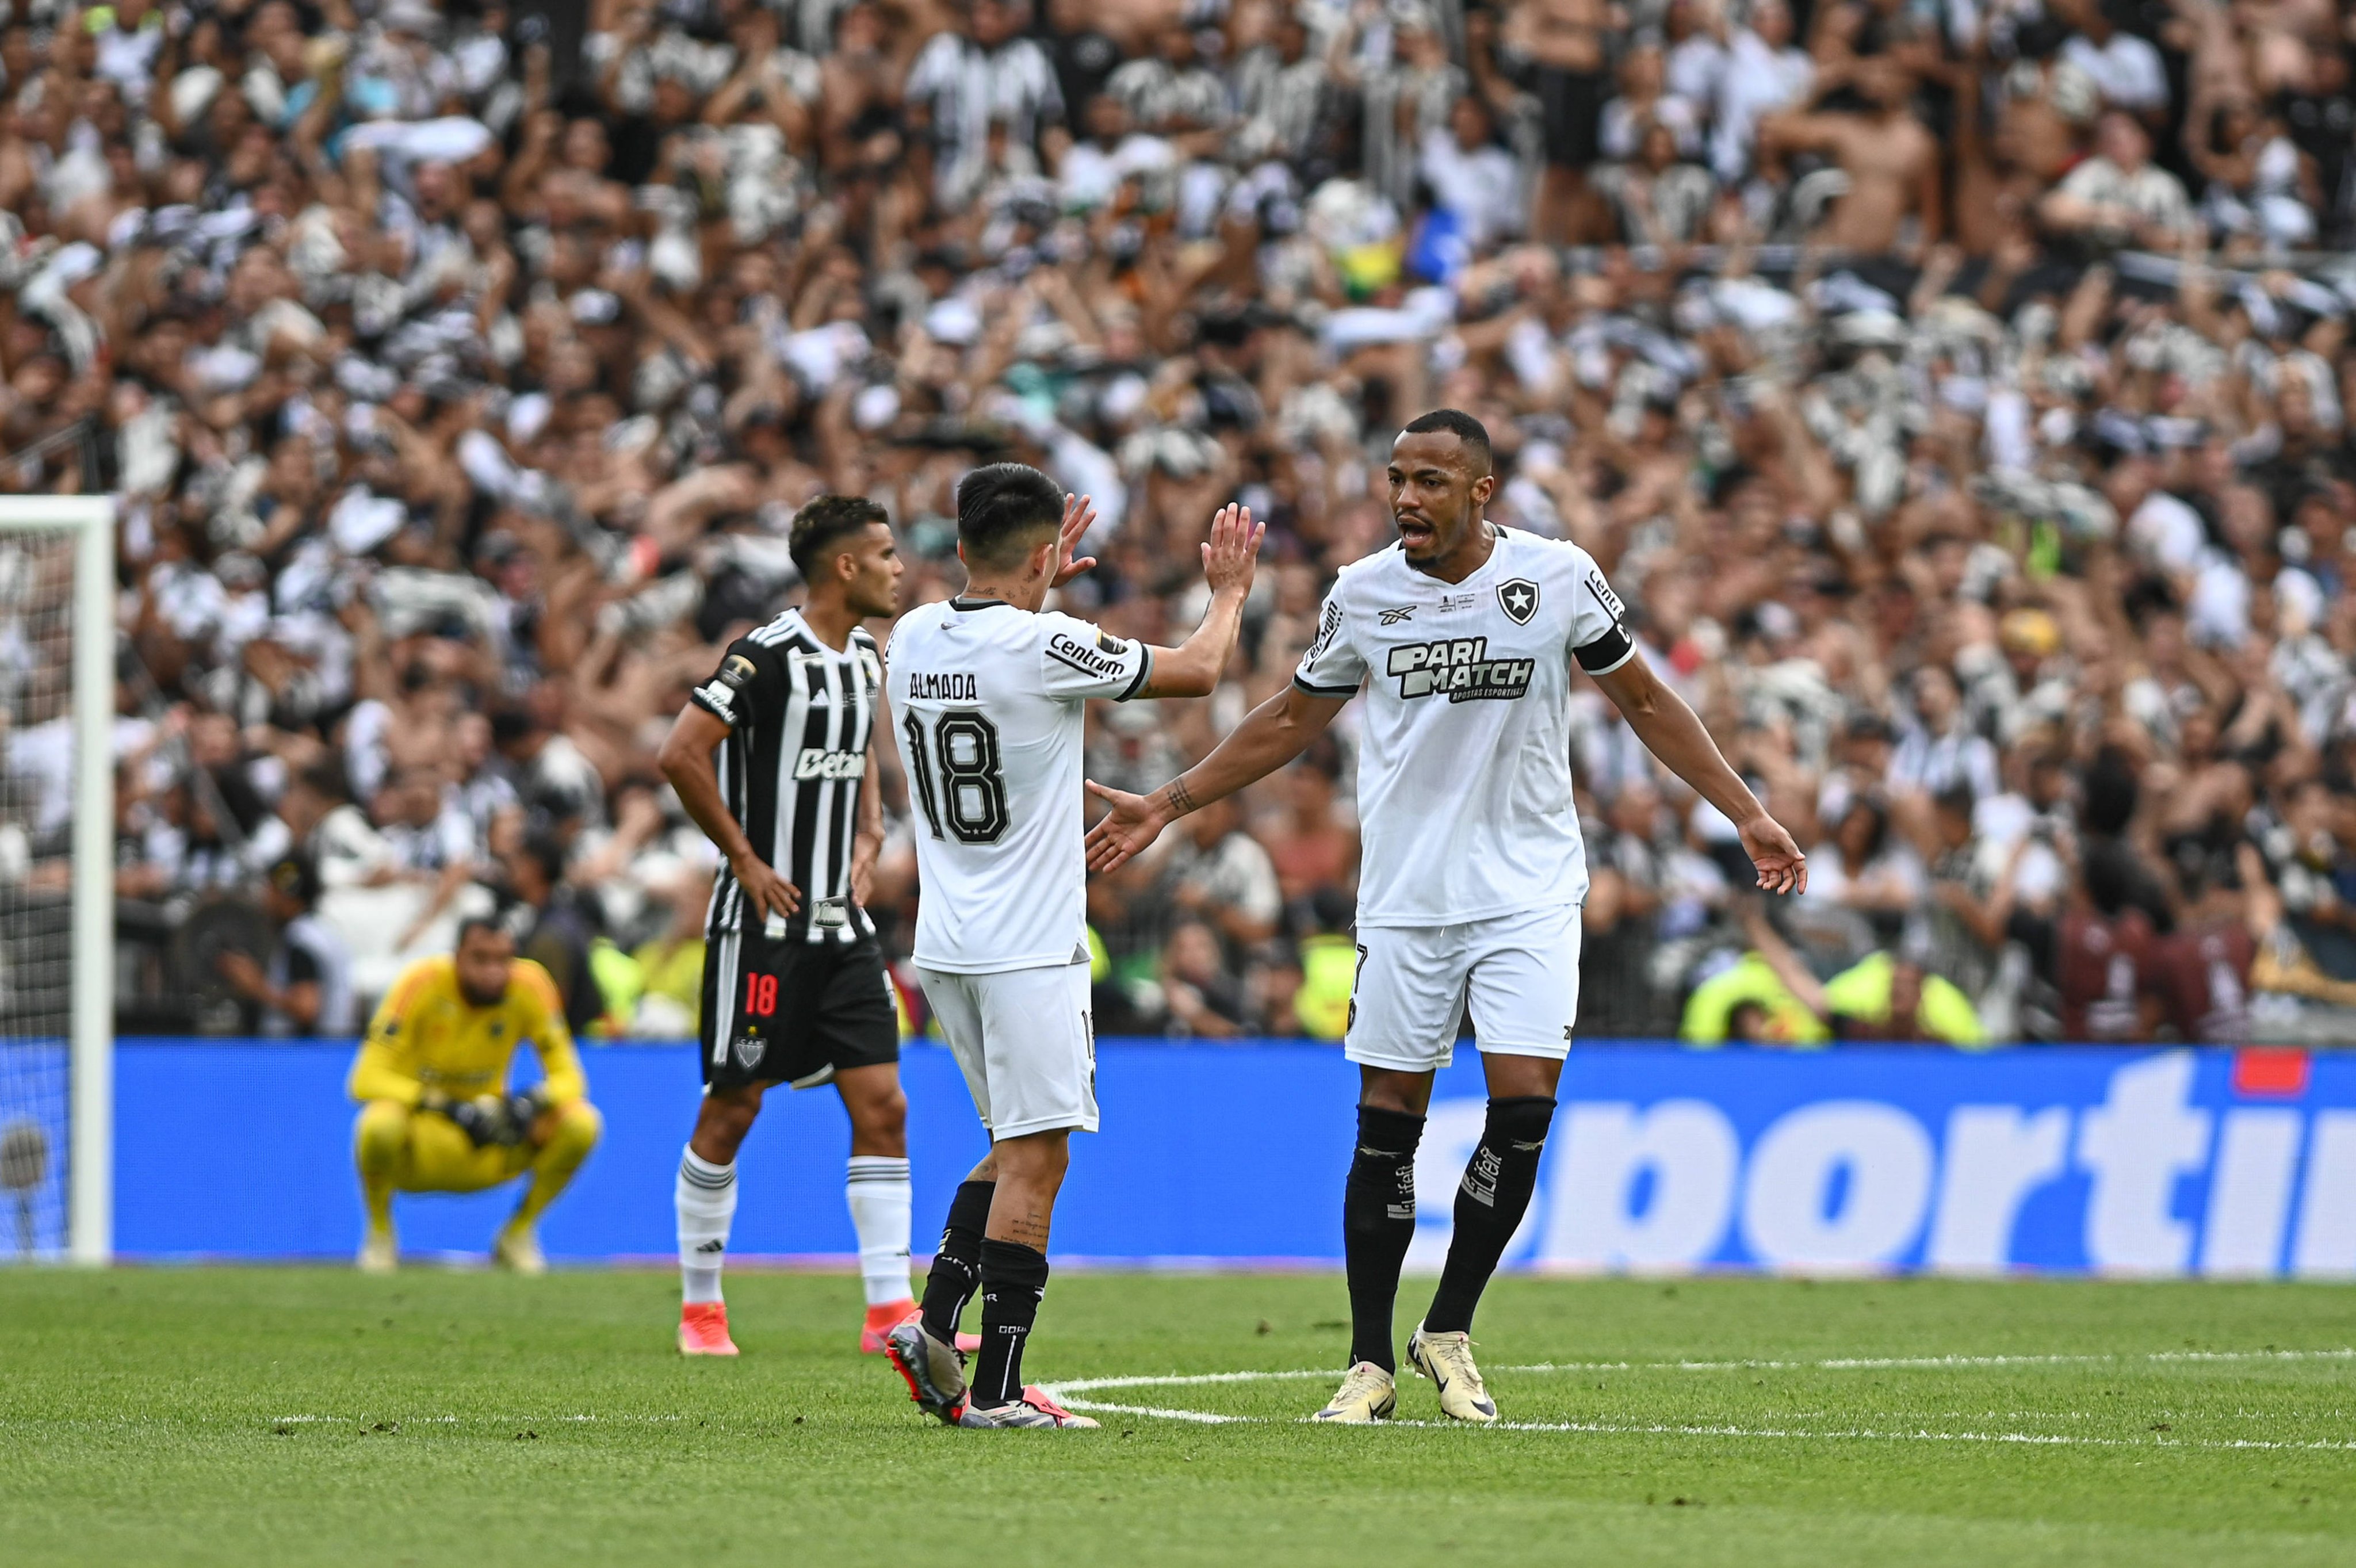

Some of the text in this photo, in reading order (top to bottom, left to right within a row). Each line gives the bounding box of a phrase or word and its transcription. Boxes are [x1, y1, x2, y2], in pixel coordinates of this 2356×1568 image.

[1050, 633, 1125, 675] Centrum
[1390, 640, 1483, 673] PARI
[909, 673, 977, 700] ALMADA
[1403, 662, 1532, 695] MATCH
[1452, 689, 1483, 700] APOSTAS
[902, 706, 1011, 845] 18
[745, 972, 778, 1017] 18
